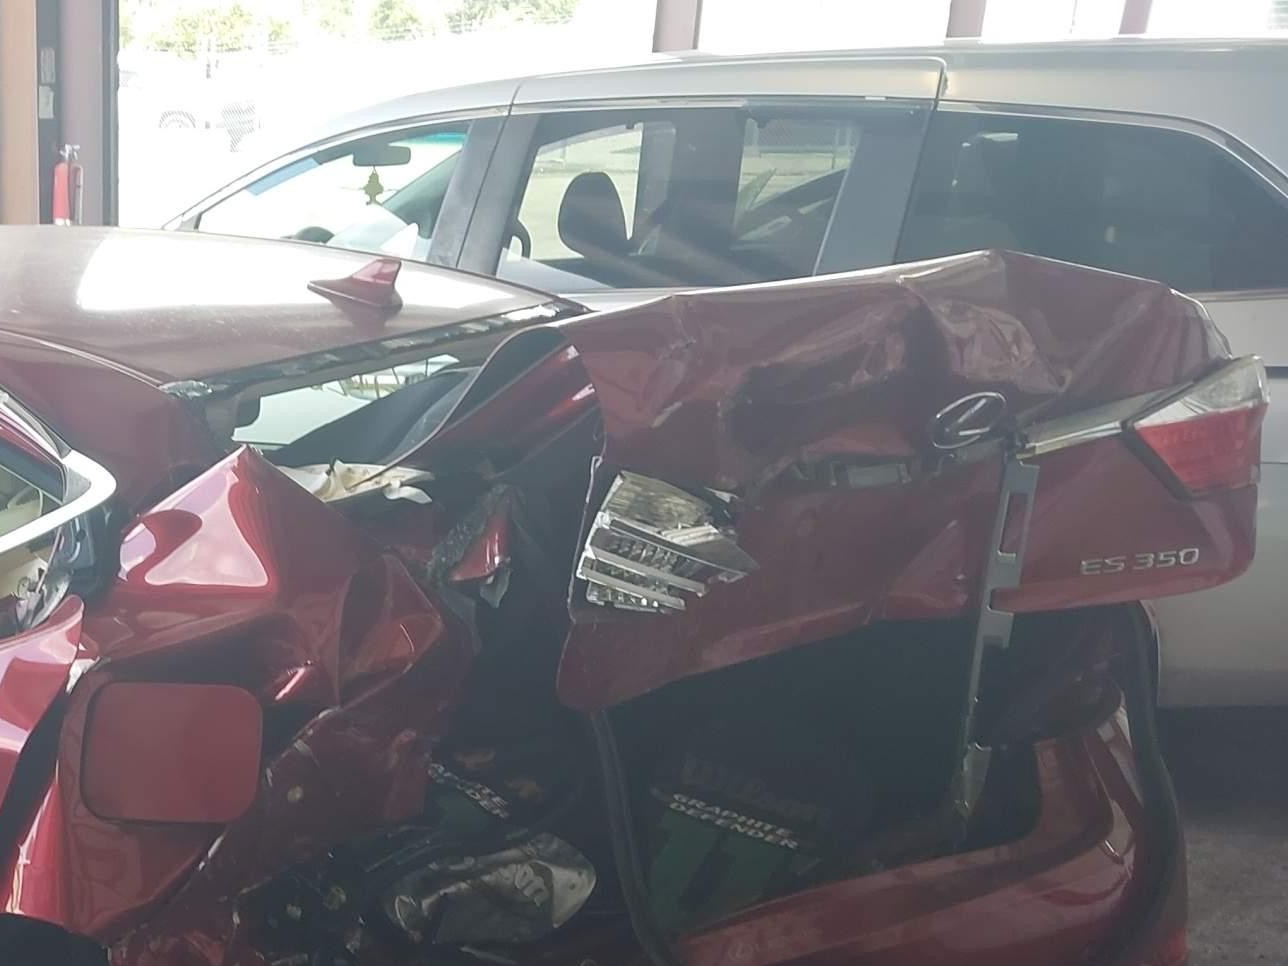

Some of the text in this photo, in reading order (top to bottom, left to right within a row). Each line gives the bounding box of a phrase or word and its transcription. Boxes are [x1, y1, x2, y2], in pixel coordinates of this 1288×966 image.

[1080, 547, 1200, 575] ES 350
[669, 801, 800, 849] DEFENDER
[673, 793, 793, 835] GRAPHITE
